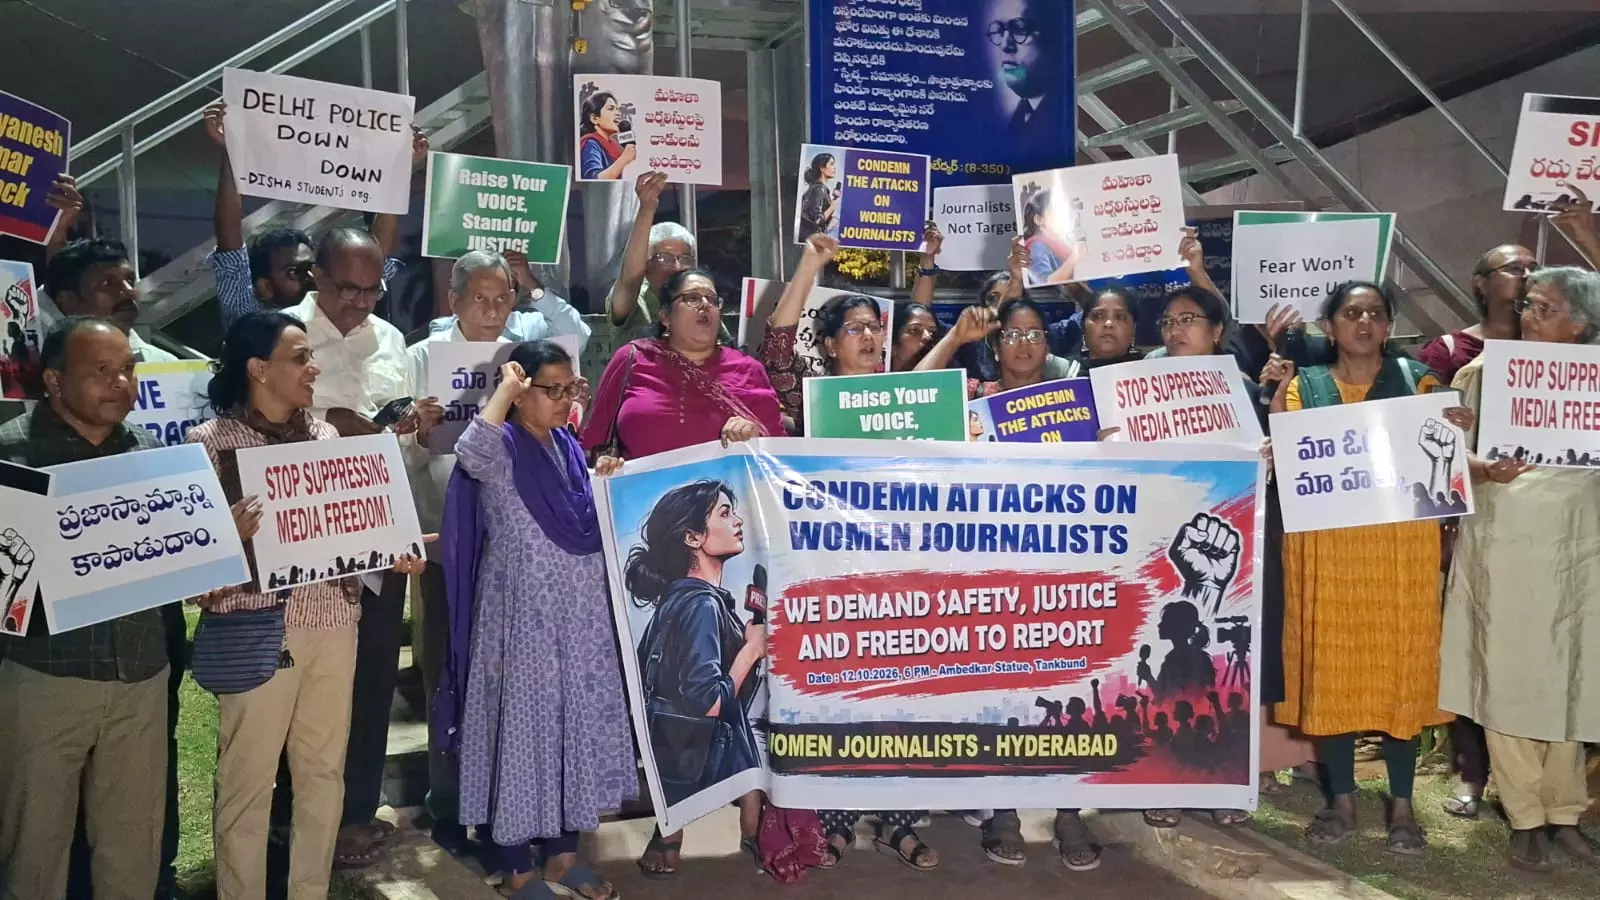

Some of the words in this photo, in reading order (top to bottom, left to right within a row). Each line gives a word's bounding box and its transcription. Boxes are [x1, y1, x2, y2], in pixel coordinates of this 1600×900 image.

[243, 88, 316, 120] DELHI
[329, 103, 402, 132] POLICE
[278, 125, 349, 149] DOWN
[320, 160, 382, 183] DOWN
[857, 158, 910, 175] CONDEMN
[457, 168, 508, 189] Raise
[512, 174, 547, 192] Your
[846, 175, 868, 189] THE
[870, 177, 919, 193] ATTACKS
[476, 192, 528, 214] VOICE,
[873, 194, 890, 208] ON
[940, 201, 1011, 215] Journalists
[462, 213, 513, 233] Stand
[515, 217, 538, 234] for
[859, 211, 901, 225] WOMEN
[947, 222, 972, 234] Not
[467, 235, 530, 254] JUSTICE
[840, 226, 916, 243] JOURNALISTS
[1259, 259, 1296, 273] Fear
[1302, 254, 1354, 272] Won't
[1259, 283, 1320, 299] Silence
[452, 367, 487, 389] మా
[1507, 358, 1544, 389] STOP
[838, 390, 891, 410] Raise
[893, 387, 938, 406] Your
[1006, 388, 1076, 414] CONDEMN
[1116, 377, 1149, 409] STOP
[1150, 370, 1231, 403] SUPPRESSING
[860, 411, 919, 433] VOICE,
[998, 418, 1028, 437] THE
[1030, 407, 1091, 428] ATTACKS
[1126, 411, 1171, 442] MEDIA
[1172, 403, 1234, 437] FREEDOM
[1510, 397, 1557, 429] MEDIA
[1040, 430, 1062, 443] ON
[1297, 436, 1335, 461] మా
[265, 463, 300, 500] STOP
[303, 453, 390, 495] SUPPRESSING
[1294, 471, 1333, 496] మా
[782, 479, 940, 513] CONDEMN
[946, 482, 1086, 514] ATTACKS
[1094, 484, 1137, 515] ON
[276, 505, 323, 544] MEDIA
[324, 495, 388, 536] FREEDOM
[788, 520, 912, 551] WOMEN
[918, 522, 1129, 555] JOURNALISTS
[783, 596, 820, 624] WE
[826, 589, 930, 621] DEMAND
[937, 584, 1026, 617] SAFETY,
[1033, 581, 1117, 614] JUSTICE
[798, 631, 850, 662] AND
[856, 625, 969, 658] FREEDOM
[973, 624, 1006, 651] TO
[1012, 618, 1105, 650] REPORT
[808, 673, 831, 684] Date
[842, 668, 901, 681] 12.10.2026,
[905, 668, 911, 678] 6
[914, 666, 929, 677] PM
[939, 663, 992, 675] Ambedkar
[995, 661, 1032, 674] Statue,
[1035, 657, 1086, 670] Tankbund
[838, 734, 978, 759] JOURNALISTS
[996, 734, 1117, 758] HYDERABAD
